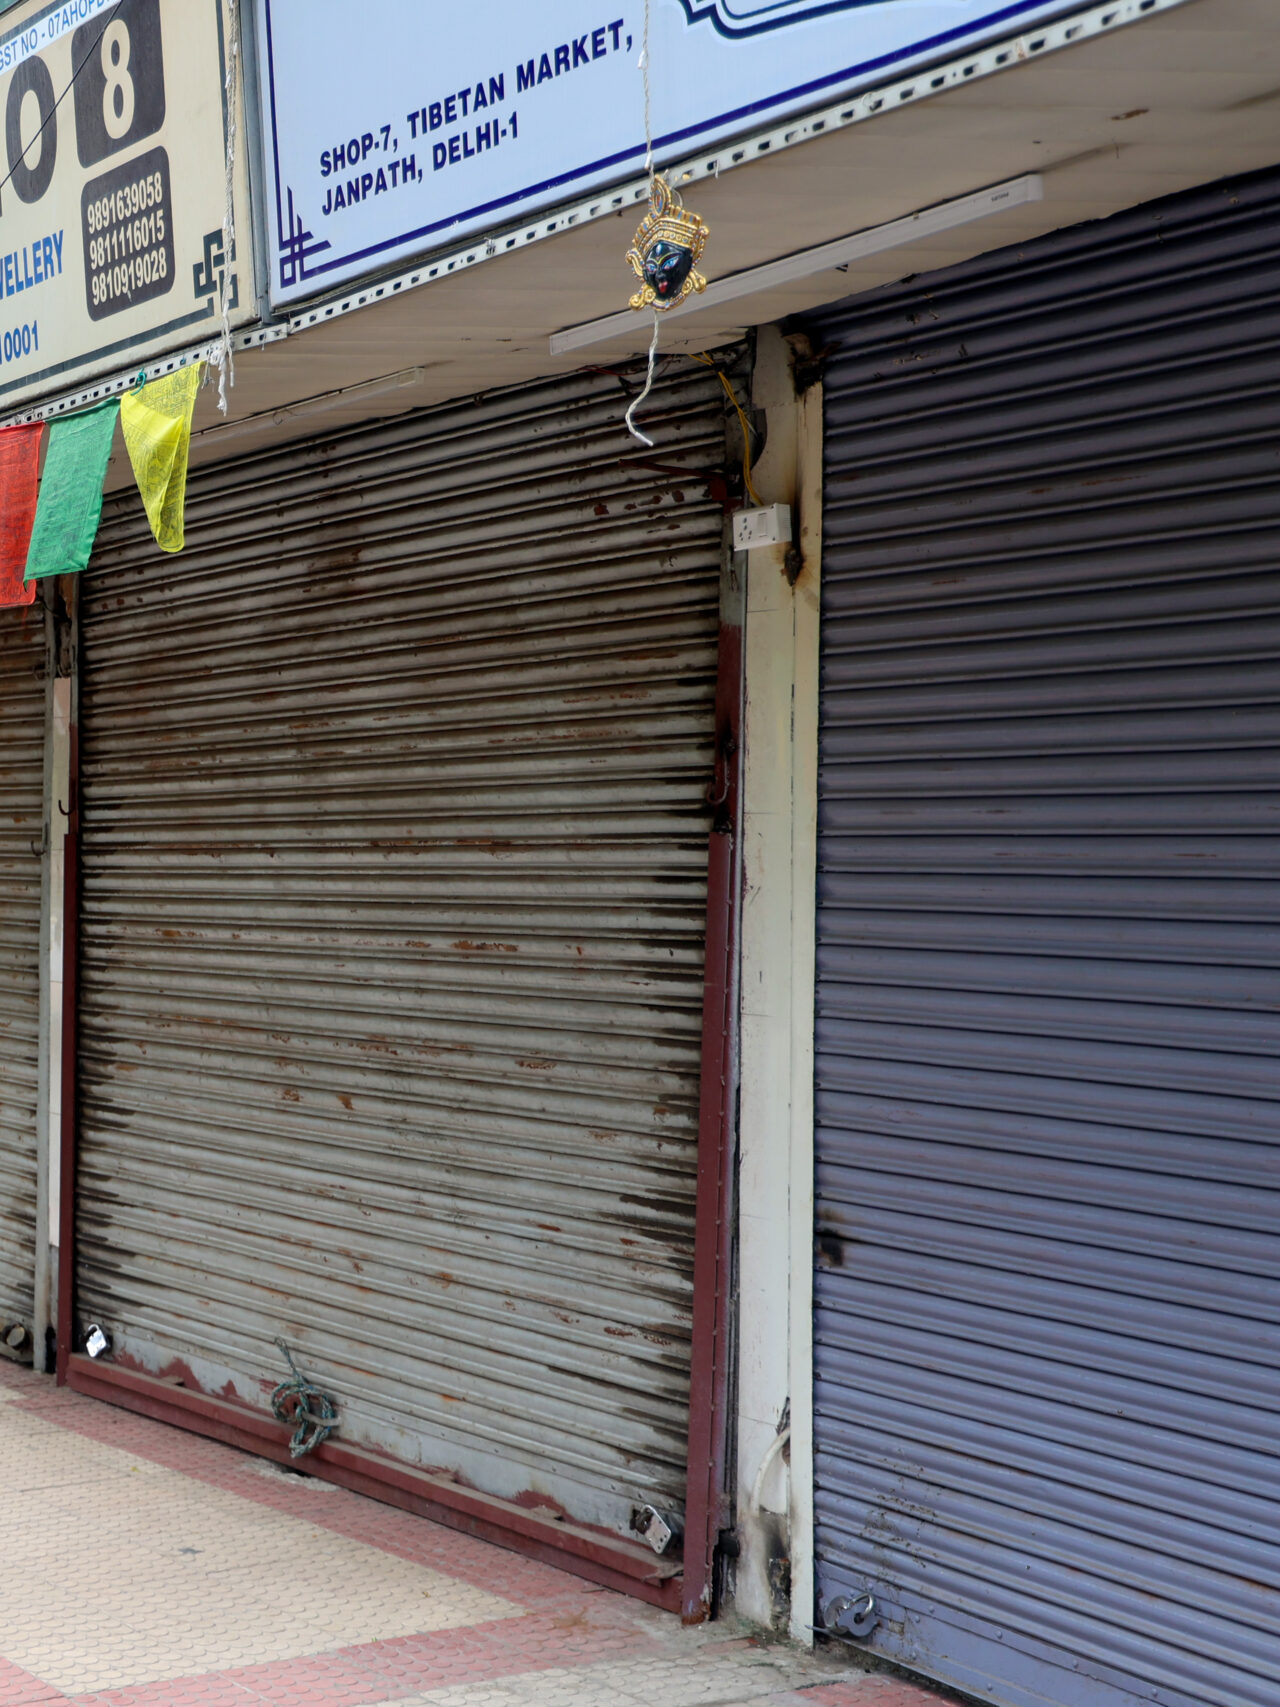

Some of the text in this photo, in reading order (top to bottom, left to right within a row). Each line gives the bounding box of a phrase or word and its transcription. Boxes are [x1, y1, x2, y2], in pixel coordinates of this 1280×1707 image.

[21, 28, 38, 57] NO
[101, 19, 135, 139] 8
[320, 18, 633, 177] SHOP-7, TIBETAN MARKET,
[322, 111, 518, 216] JANPATH, DELHI-1
[87, 172, 162, 234] 9891639058
[90, 209, 165, 270] 9811116015
[92, 247, 167, 306] 9810919028
